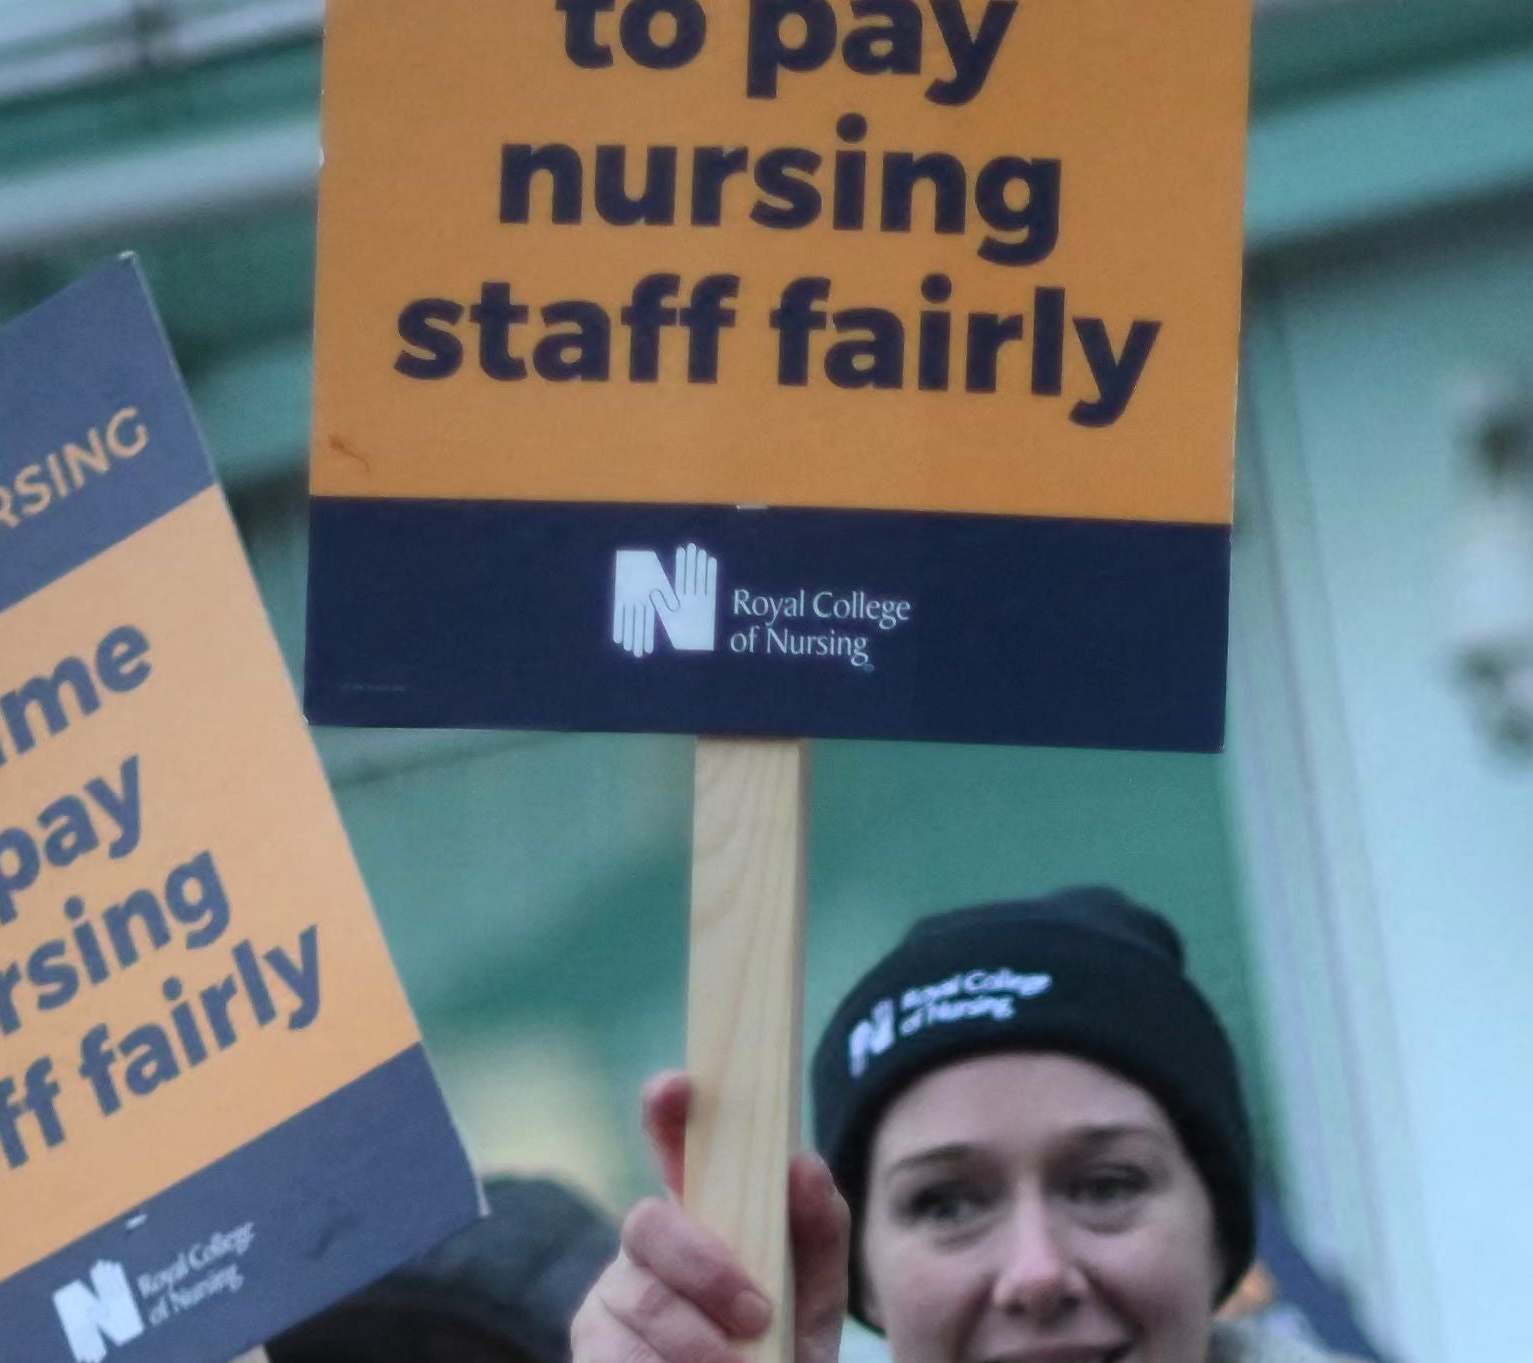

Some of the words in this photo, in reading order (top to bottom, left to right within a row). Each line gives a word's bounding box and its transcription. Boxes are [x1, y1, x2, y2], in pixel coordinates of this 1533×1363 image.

[746, 0, 1017, 106] pay
[500, 113, 1062, 267] nursing
[393, 273, 741, 385] staff
[770, 273, 1164, 429] fairly
[729, 626, 761, 656] of
[764, 627, 870, 666] Nursing
[732, 587, 808, 624] Royal
[811, 590, 912, 627] College
[77, 922, 324, 1120] fairly
